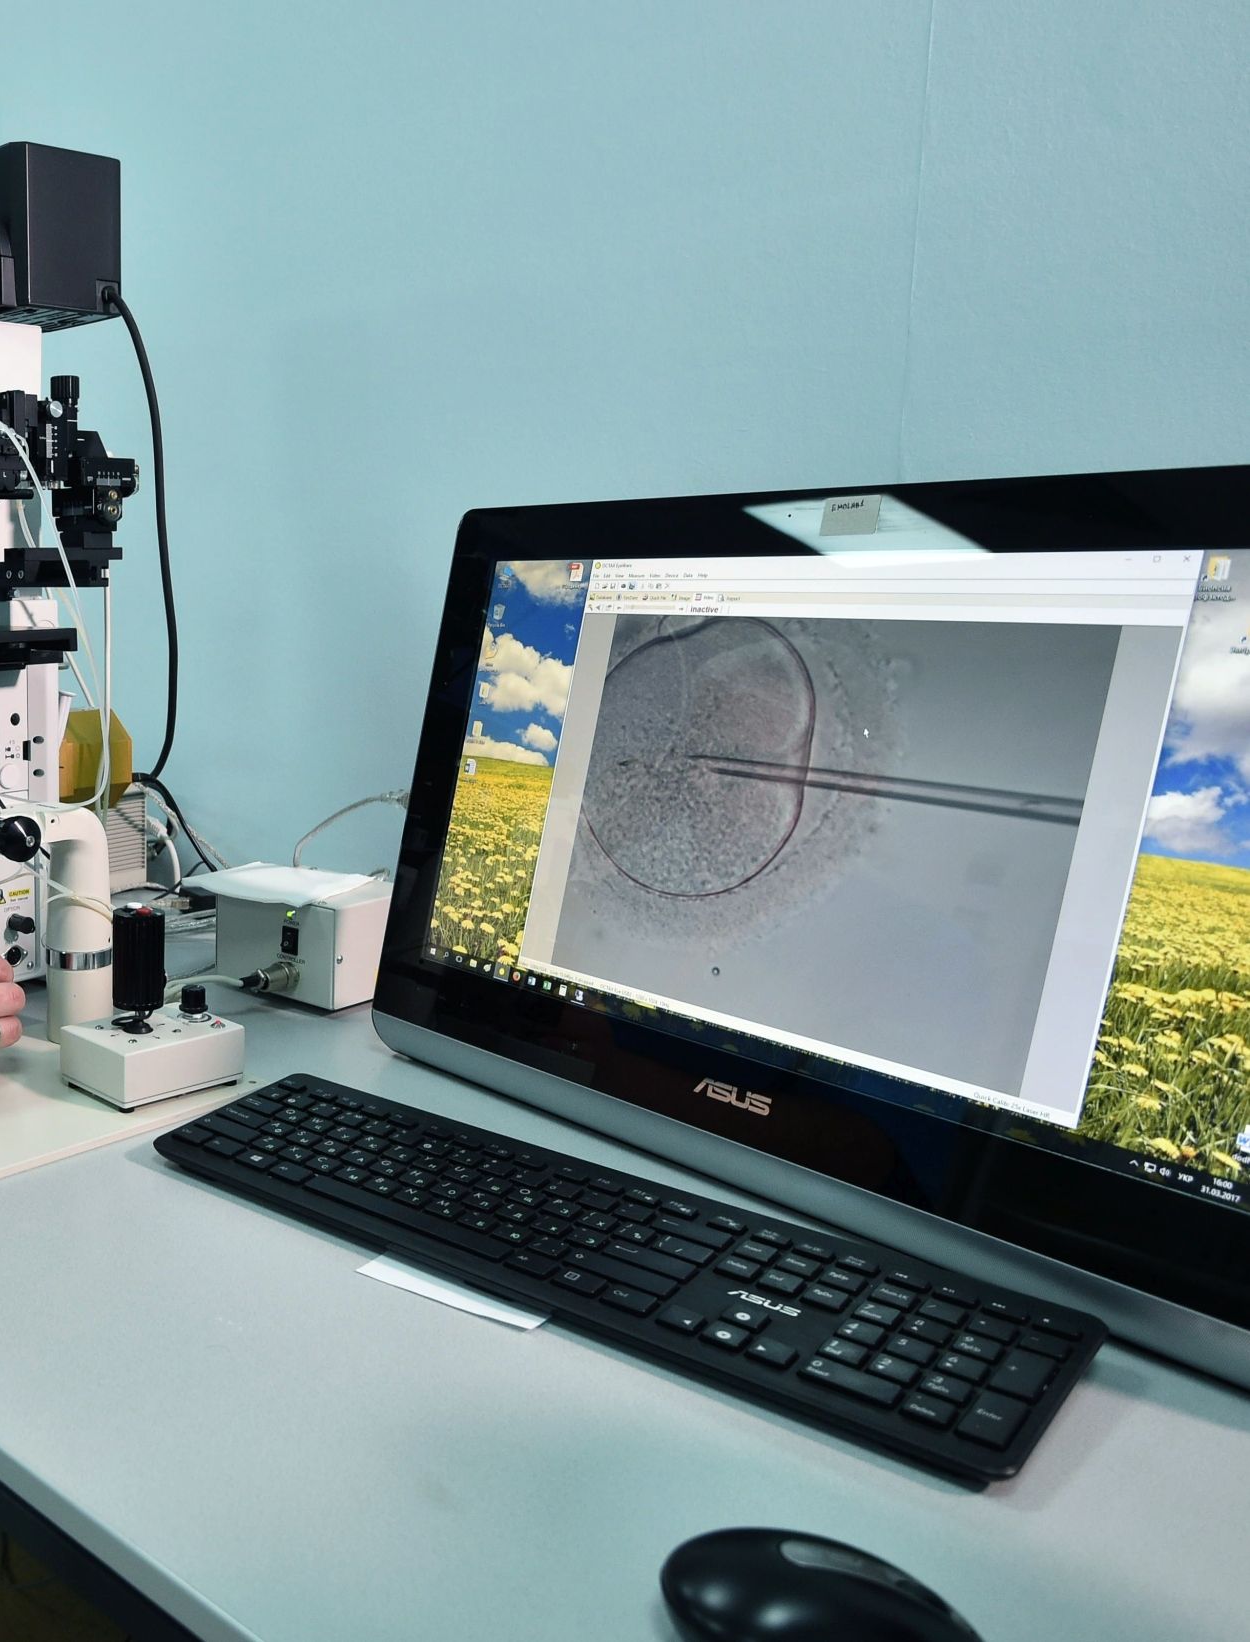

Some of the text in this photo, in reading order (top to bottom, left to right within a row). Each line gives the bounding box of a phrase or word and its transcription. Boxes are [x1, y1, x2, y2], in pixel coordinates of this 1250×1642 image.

[8, 889, 30, 897] CAUTION
[693, 1077, 773, 1116] ASUS
[1201, 1185, 1241, 1203] 31.03.2017
[727, 1290, 802, 1317] ASUS
[976, 1408, 1003, 1421] Enter
